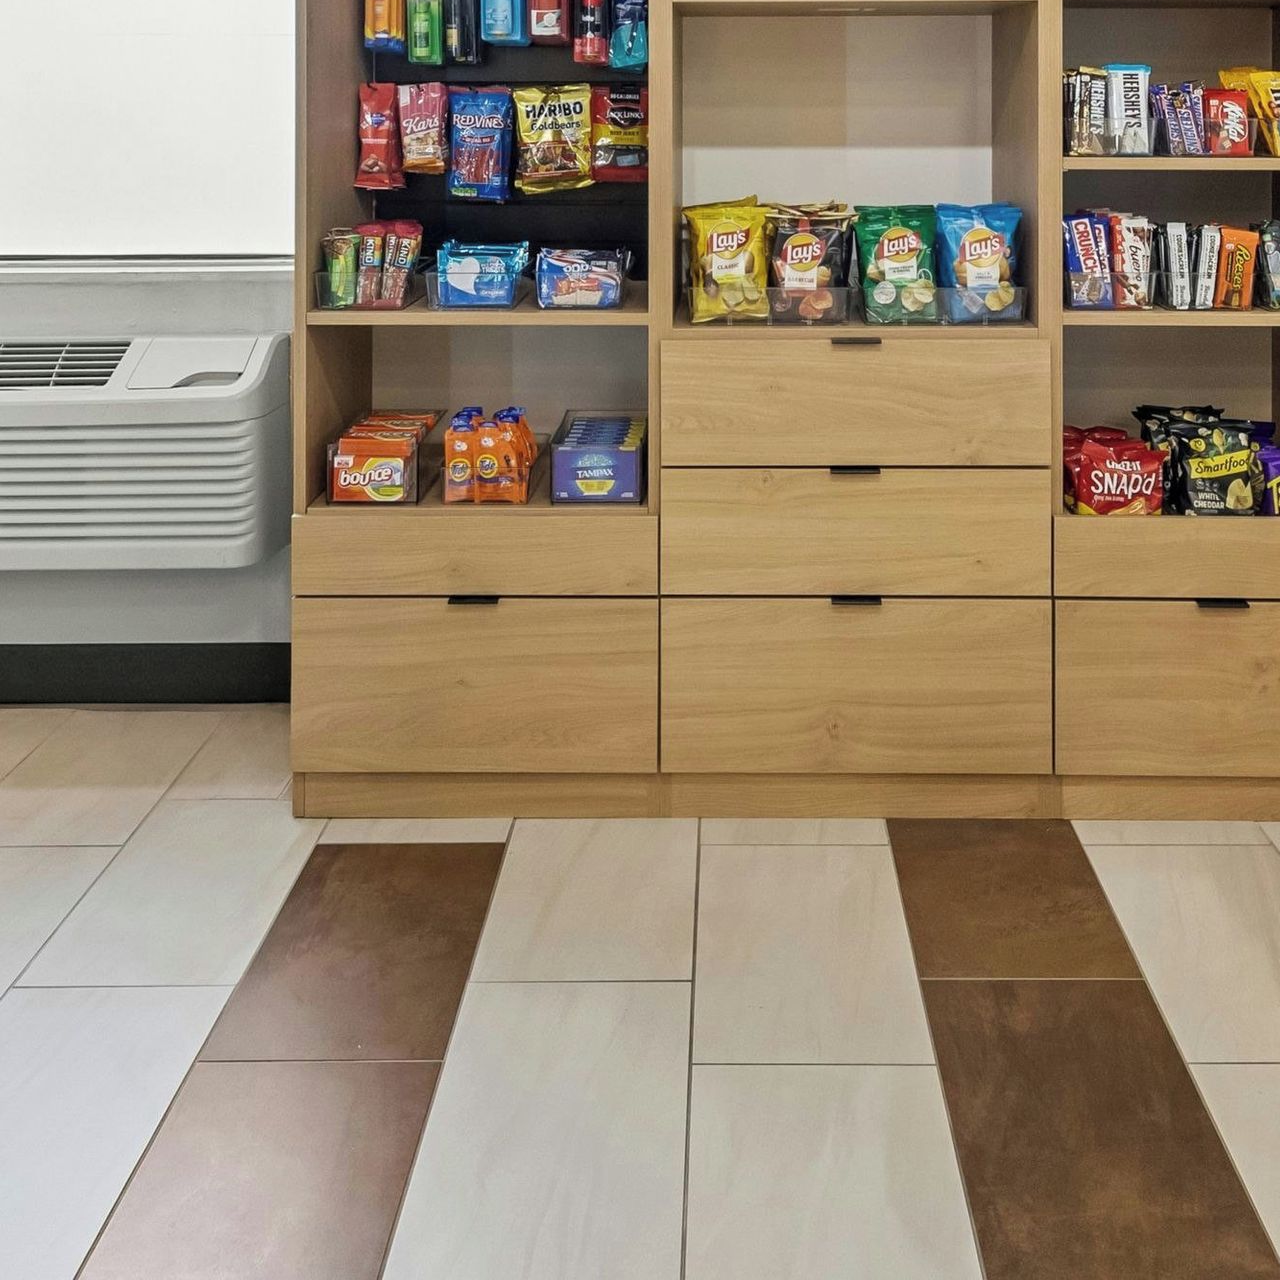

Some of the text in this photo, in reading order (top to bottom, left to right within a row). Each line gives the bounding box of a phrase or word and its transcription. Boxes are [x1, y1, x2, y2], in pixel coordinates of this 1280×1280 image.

[525, 101, 583, 119] HARIBO
[1090, 80, 1106, 135] HERSHEY'S
[1123, 73, 1142, 128] HERSHEY'S
[531, 120, 581, 131] Goldbears
[1179, 110, 1199, 153] SNICKERS
[366, 238, 375, 263] KIND
[712, 231, 747, 251] Lay's
[883, 233, 917, 255] Lay's
[965, 236, 1000, 257] Lay's
[398, 237, 410, 267] KIND
[787, 242, 821, 265] Lay's
[1129, 245, 1143, 282] bueno
[338, 466, 392, 487] bounce
[479, 460, 497, 472] Tide
[576, 468, 614, 478] TAMPAX
[1194, 500, 1225, 510] CHEDDAR
[1198, 492, 1220, 500] WHITE
